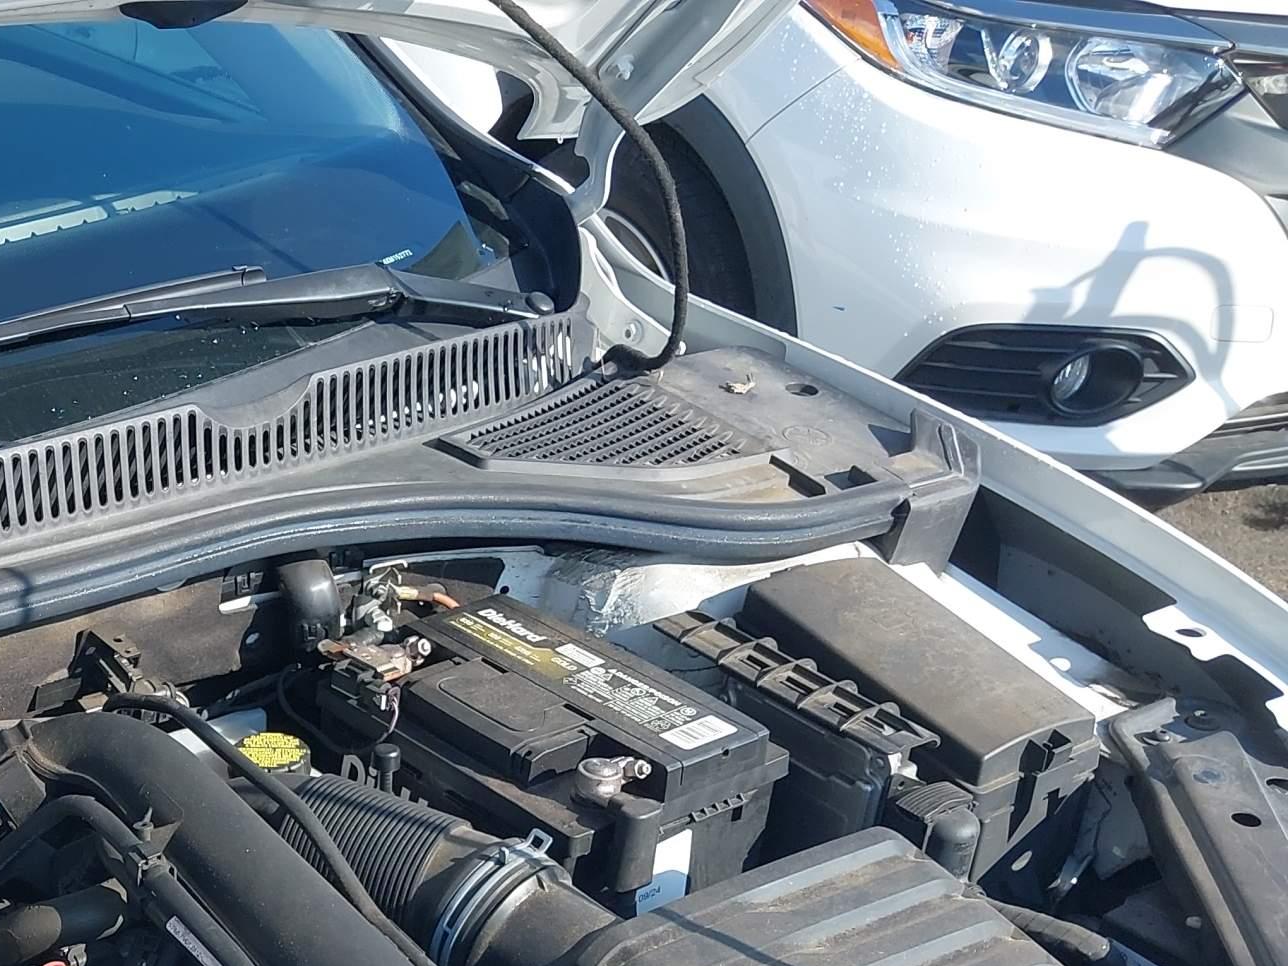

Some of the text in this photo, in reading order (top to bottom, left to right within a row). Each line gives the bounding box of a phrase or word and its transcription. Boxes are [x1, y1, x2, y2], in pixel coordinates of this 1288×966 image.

[477, 608, 549, 643] DieHard
[551, 656, 578, 671] GOLD
[638, 886, 661, 903] 09/24
